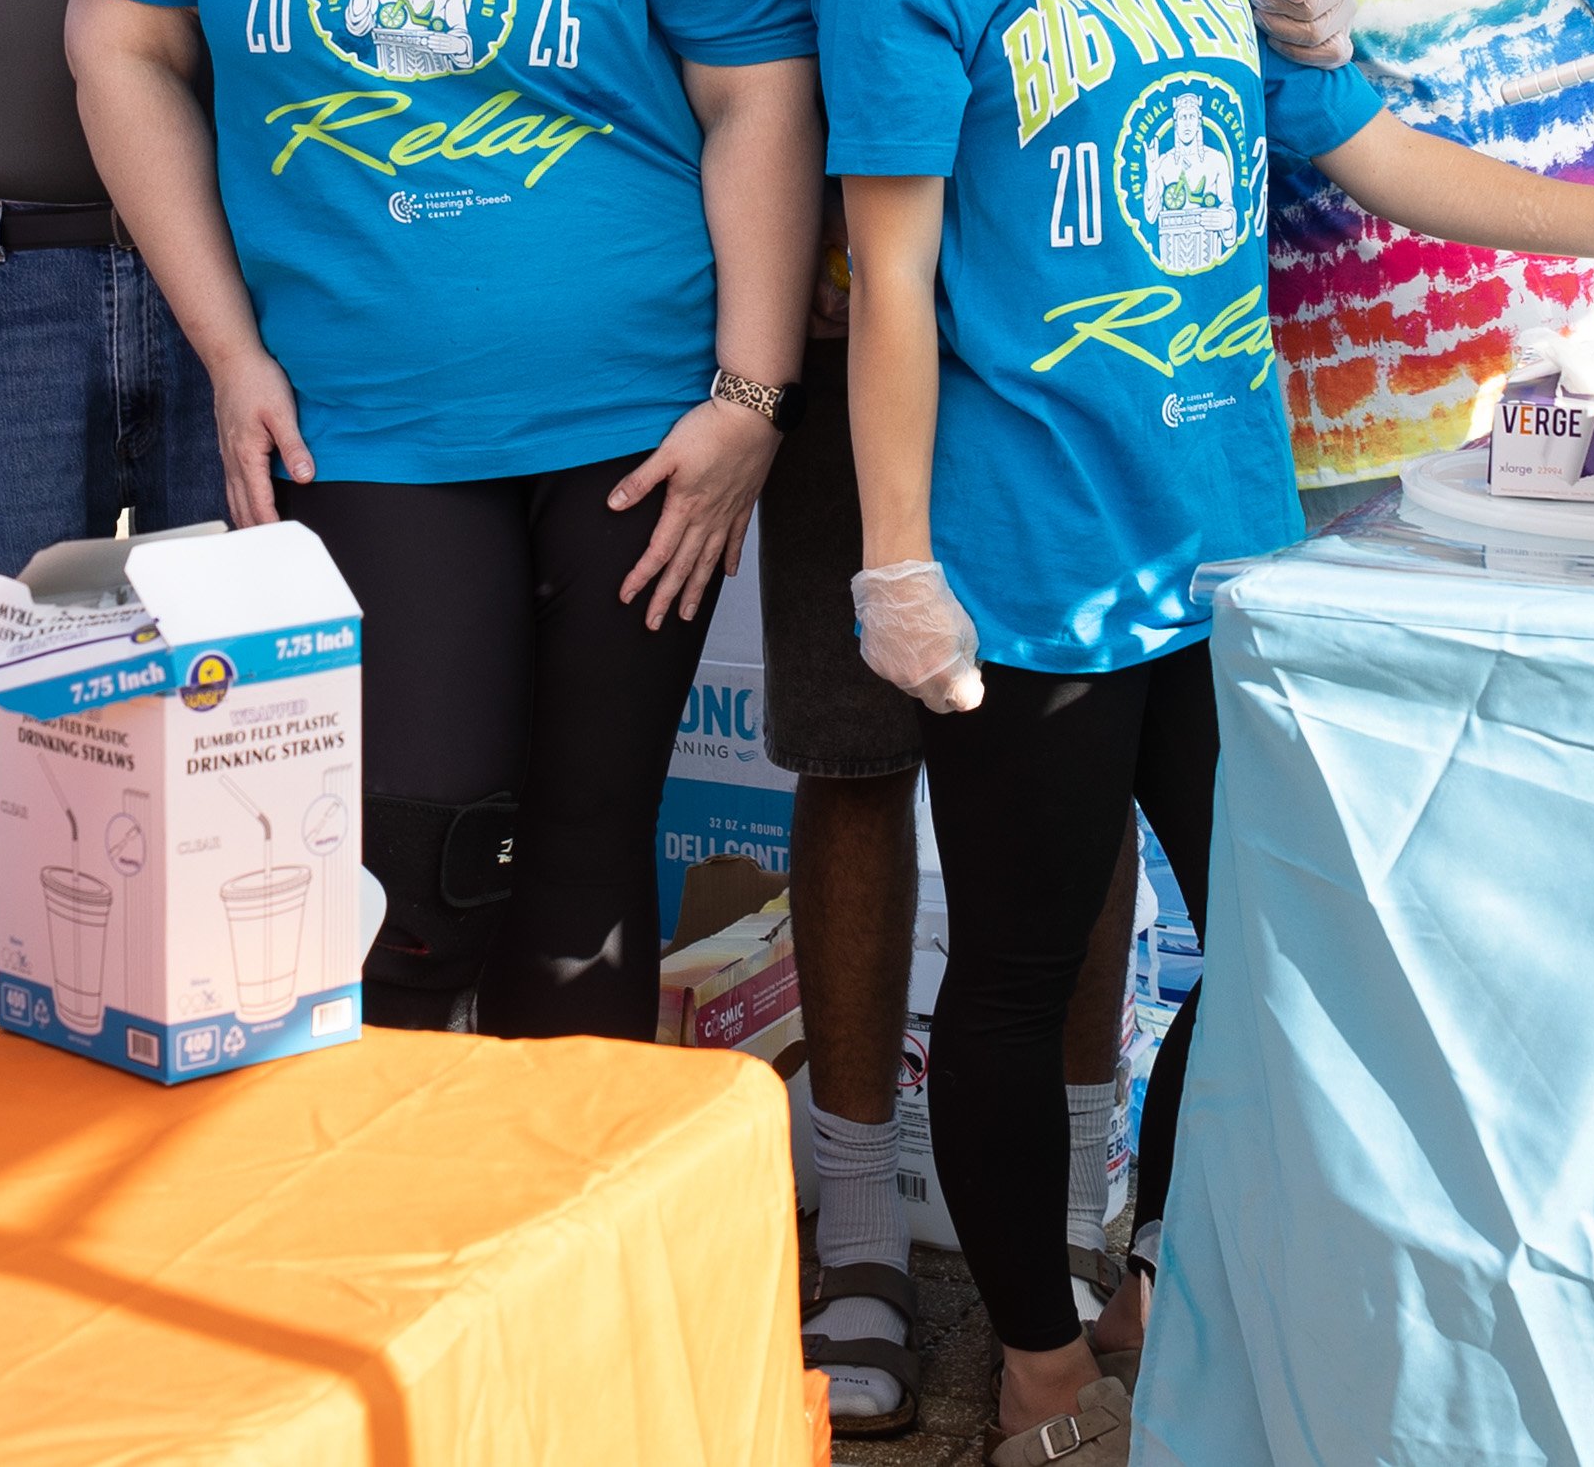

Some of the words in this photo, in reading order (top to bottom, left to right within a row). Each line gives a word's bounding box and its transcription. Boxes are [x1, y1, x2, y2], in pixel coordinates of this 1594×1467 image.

[265, 90, 614, 189] Relay
[1133, 101, 1168, 153] ANNUAL
[1210, 98, 1249, 187] CLEVELAND
[424, 189, 474, 199] CLEVELAND
[1050, 141, 1103, 248] 20
[1130, 162, 1143, 200] 14TH
[426, 198, 464, 209] Hearing
[466, 197, 474, 206] &
[475, 193, 511, 206] Speech
[428, 211, 462, 219] CENTER
[1502, 405, 1582, 438] VERGE
[1499, 463, 1533, 476] xlarge
[276, 634, 313, 661] 7.75
[316, 625, 354, 653] Inch
[70, 674, 115, 705] 7.75
[117, 662, 166, 691] Inch
[18, 727, 79, 759] DRINKING
[82, 743, 135, 772] STRAWS
[85, 723, 129, 748] PLASTIC
[194, 730, 246, 752] JUMBO
[251, 724, 282, 741] FLEX
[287, 712, 339, 735] PLASTIC
[186, 746, 276, 776] DRINKING
[282, 732, 345, 760] STRAWS
[709, 817, 721, 828] 32
[725, 819, 738, 831] OZ
[750, 823, 783, 837] ROUND
[705, 1001, 744, 1038] COSMIC
[724, 1021, 744, 1042] CRISP
